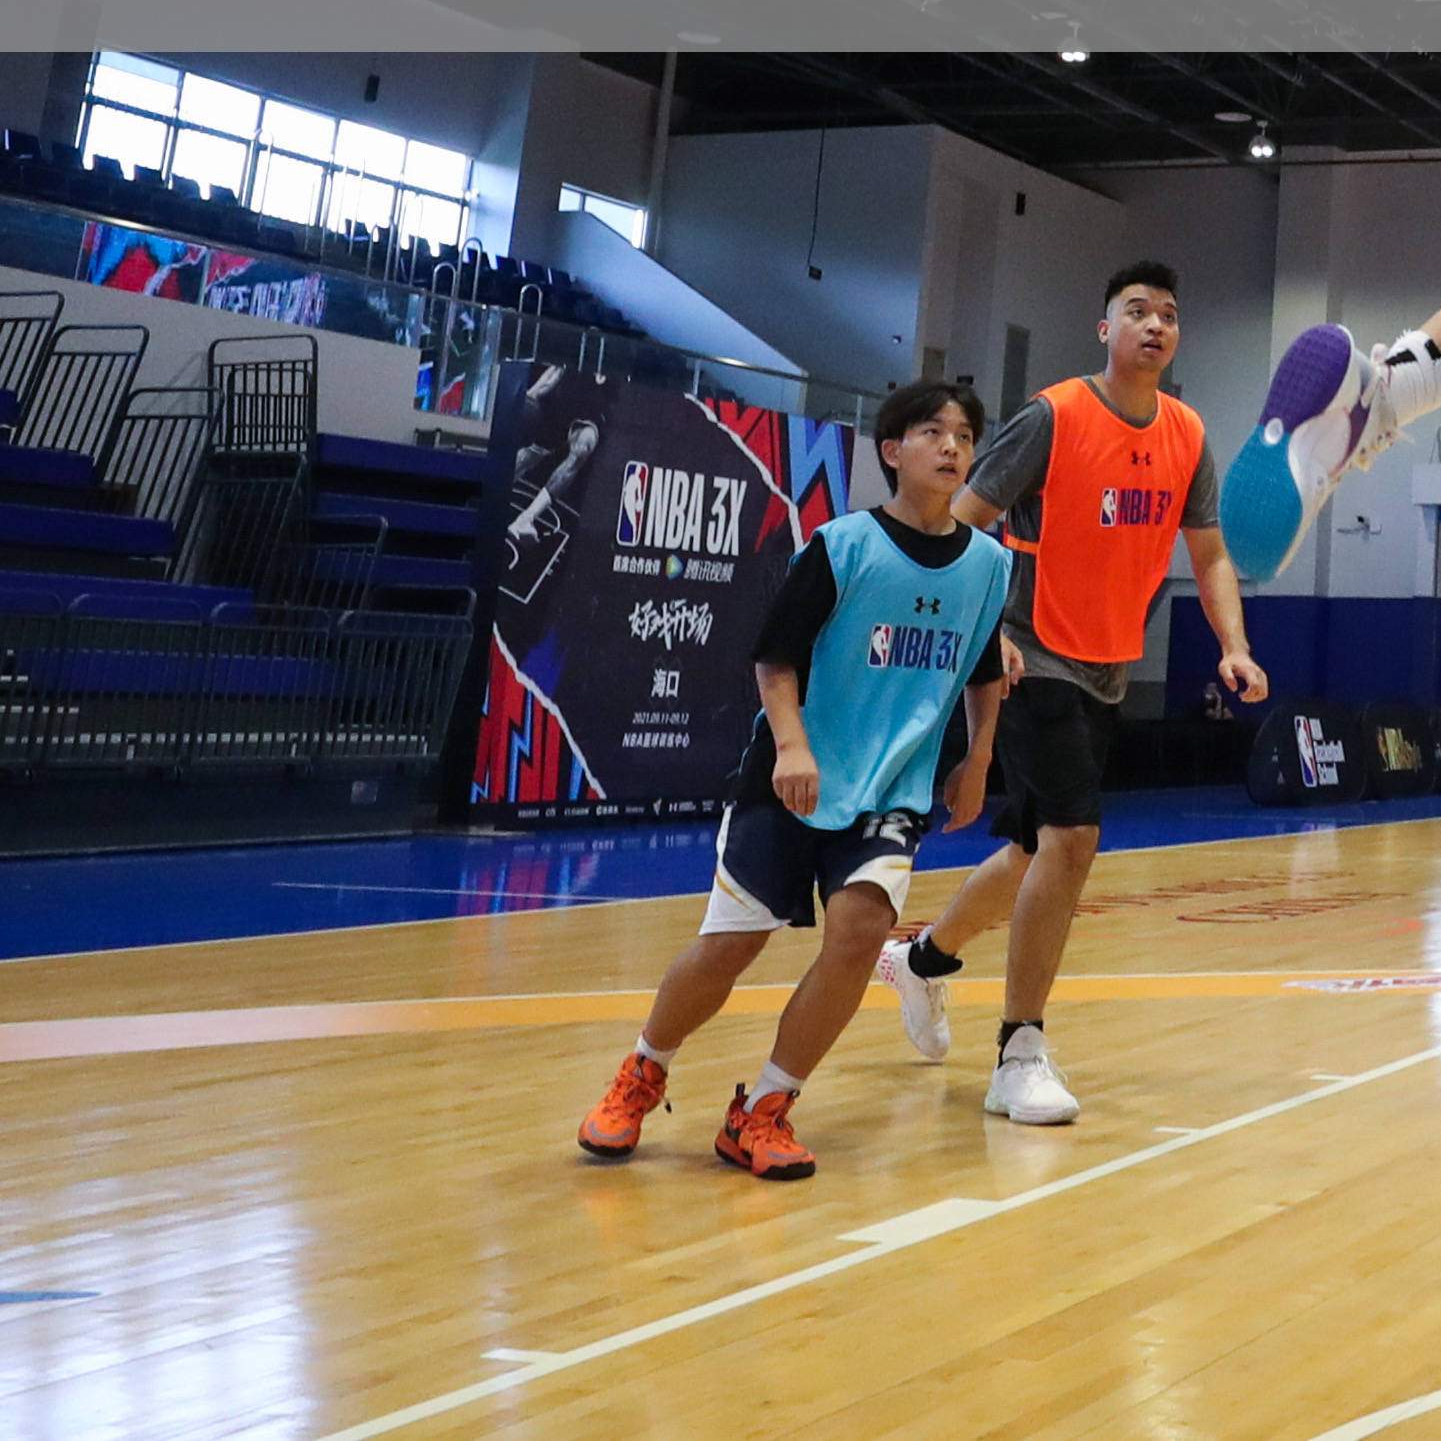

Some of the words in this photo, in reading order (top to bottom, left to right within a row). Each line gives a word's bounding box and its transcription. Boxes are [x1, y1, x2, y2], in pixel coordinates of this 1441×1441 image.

[644, 466, 705, 553] NBA
[706, 475, 748, 557] 3X
[1118, 488, 1152, 526] NBA
[887, 625, 935, 670] NBA
[935, 629, 963, 674] 3X
[651, 668, 681, 698] 海口
